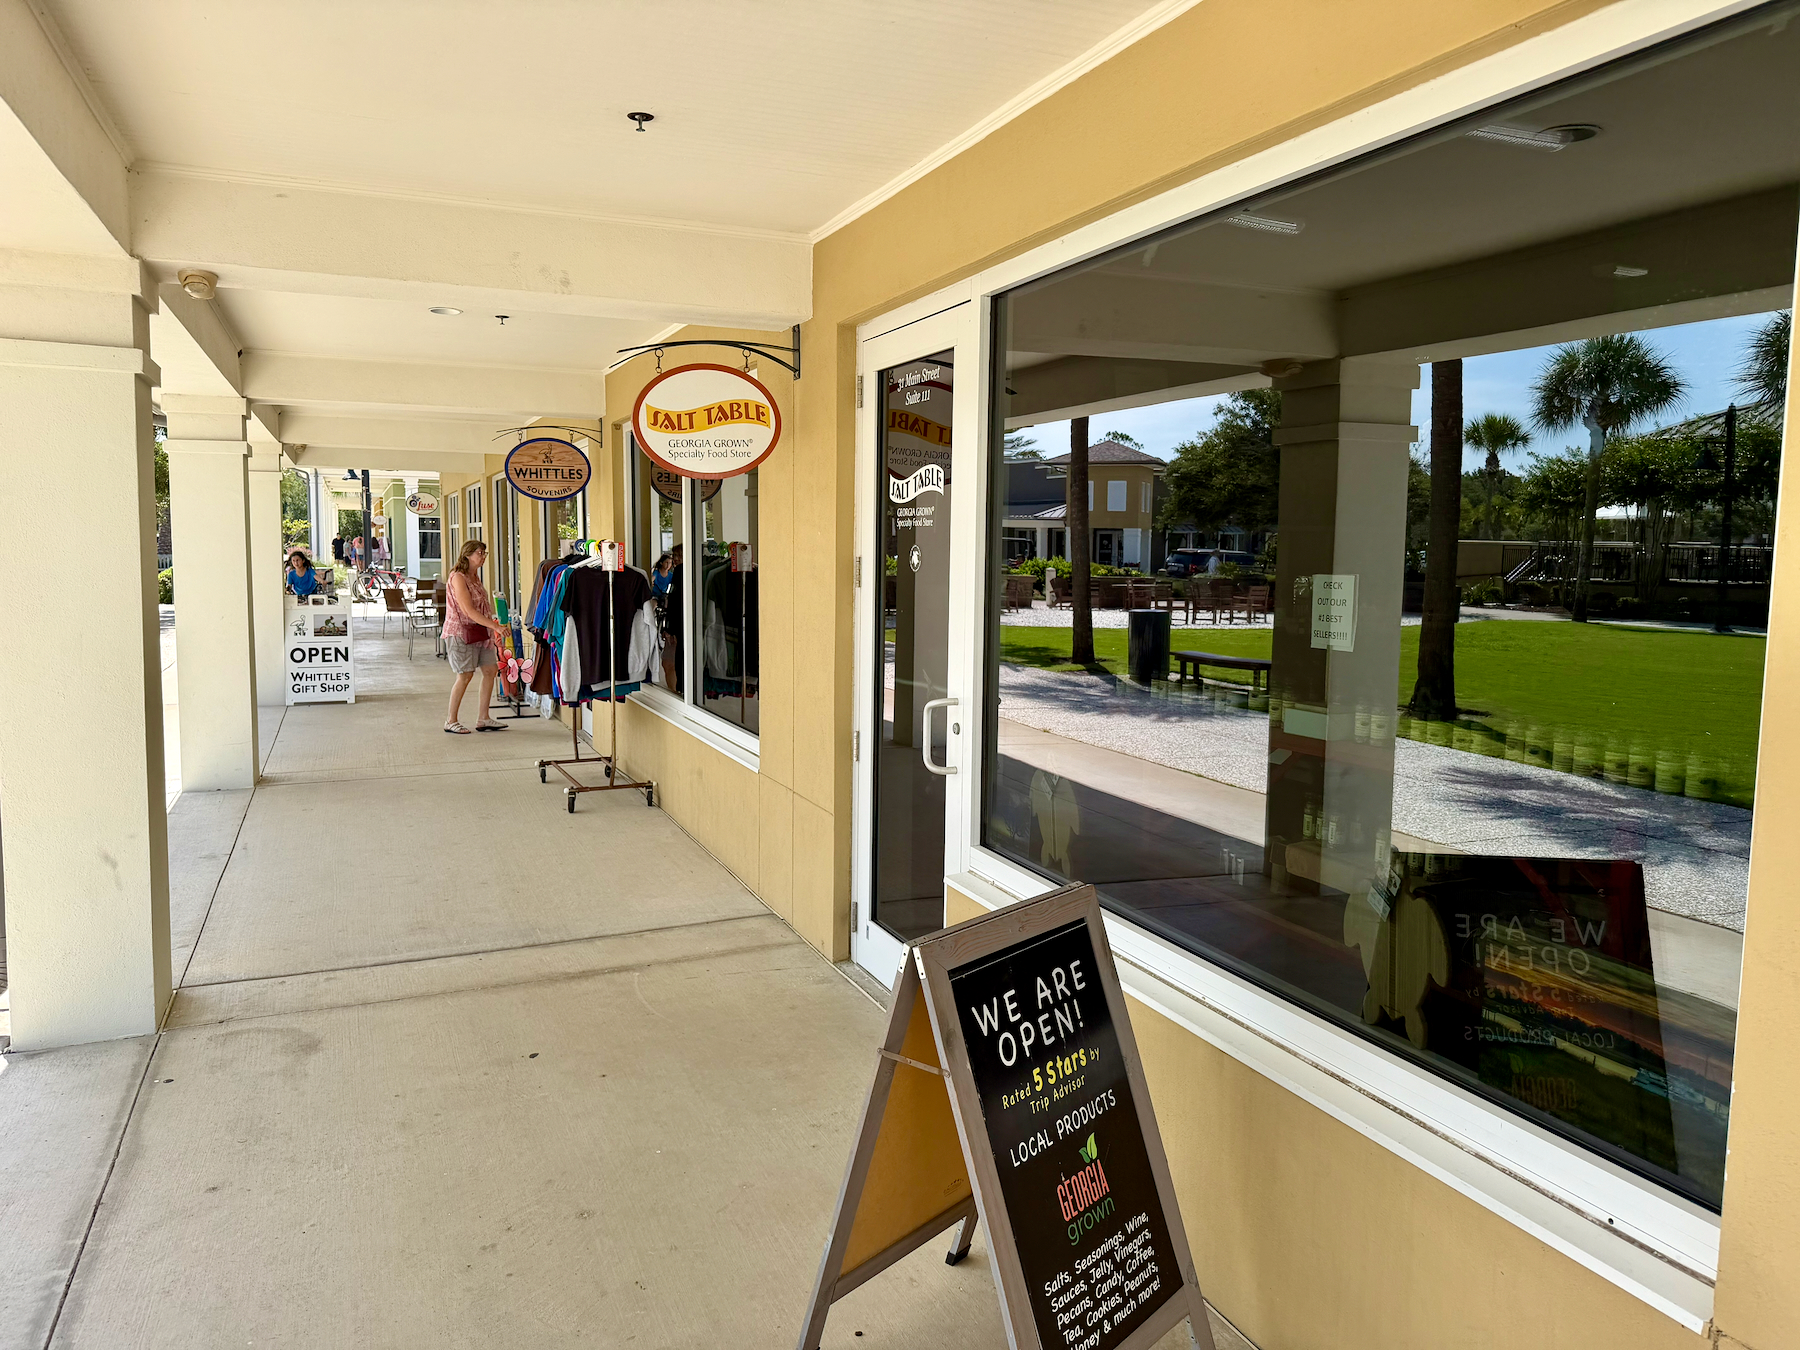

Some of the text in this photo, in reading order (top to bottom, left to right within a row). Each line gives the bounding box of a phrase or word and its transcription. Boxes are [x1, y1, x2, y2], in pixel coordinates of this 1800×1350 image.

[897, 365, 940, 393] 31 Main Street
[905, 389, 931, 406] Suite 111
[649, 402, 769, 431] SALT TABLE
[668, 439, 711, 448] GEORGIA
[668, 449, 752, 461] Specialty Food Store
[514, 467, 583, 480] WHITTLES
[891, 467, 942, 500] SALT TABLE
[526, 485, 572, 496] SOUVENIRS
[896, 517, 933, 530] Specialty Food Store
[897, 507, 916, 517] GEORGIA
[1323, 581, 1343, 590] CHECK
[1317, 597, 1347, 607] OUT OUR
[1325, 614, 1343, 623] BEST
[1313, 629, 1348, 641] SELLERS!!!!
[290, 647, 349, 663] OPEN
[290, 671, 350, 682] WHITTLE'S
[292, 683, 350, 694] GIFT SHOP
[971, 960, 1086, 1036] WE ARE
[999, 999, 1083, 1067] OPEN!
[1001, 1047, 1100, 1110] Rated 5 Stars by
[1030, 1075, 1086, 1114] Trip Advisor
[1010, 1089, 1117, 1168] LOCAL PRODUCTS
[1057, 1159, 1110, 1222] GEORGIA
[1067, 1197, 1116, 1246] grown
[1044, 1211, 1149, 1297] Salts, Seasonings, Wine,
[1051, 1228, 1152, 1313] Sauces, Jelly, Vinegars,
[1056, 1245, 1155, 1330] Pecans, Candy, Coffee,
[1062, 1261, 1159, 1345] Tea, Cookies, Peanuts,
[1103, 1319, 1112, 1334] &
[1113, 1298, 1137, 1326] much
[1138, 1275, 1161, 1305] more!
